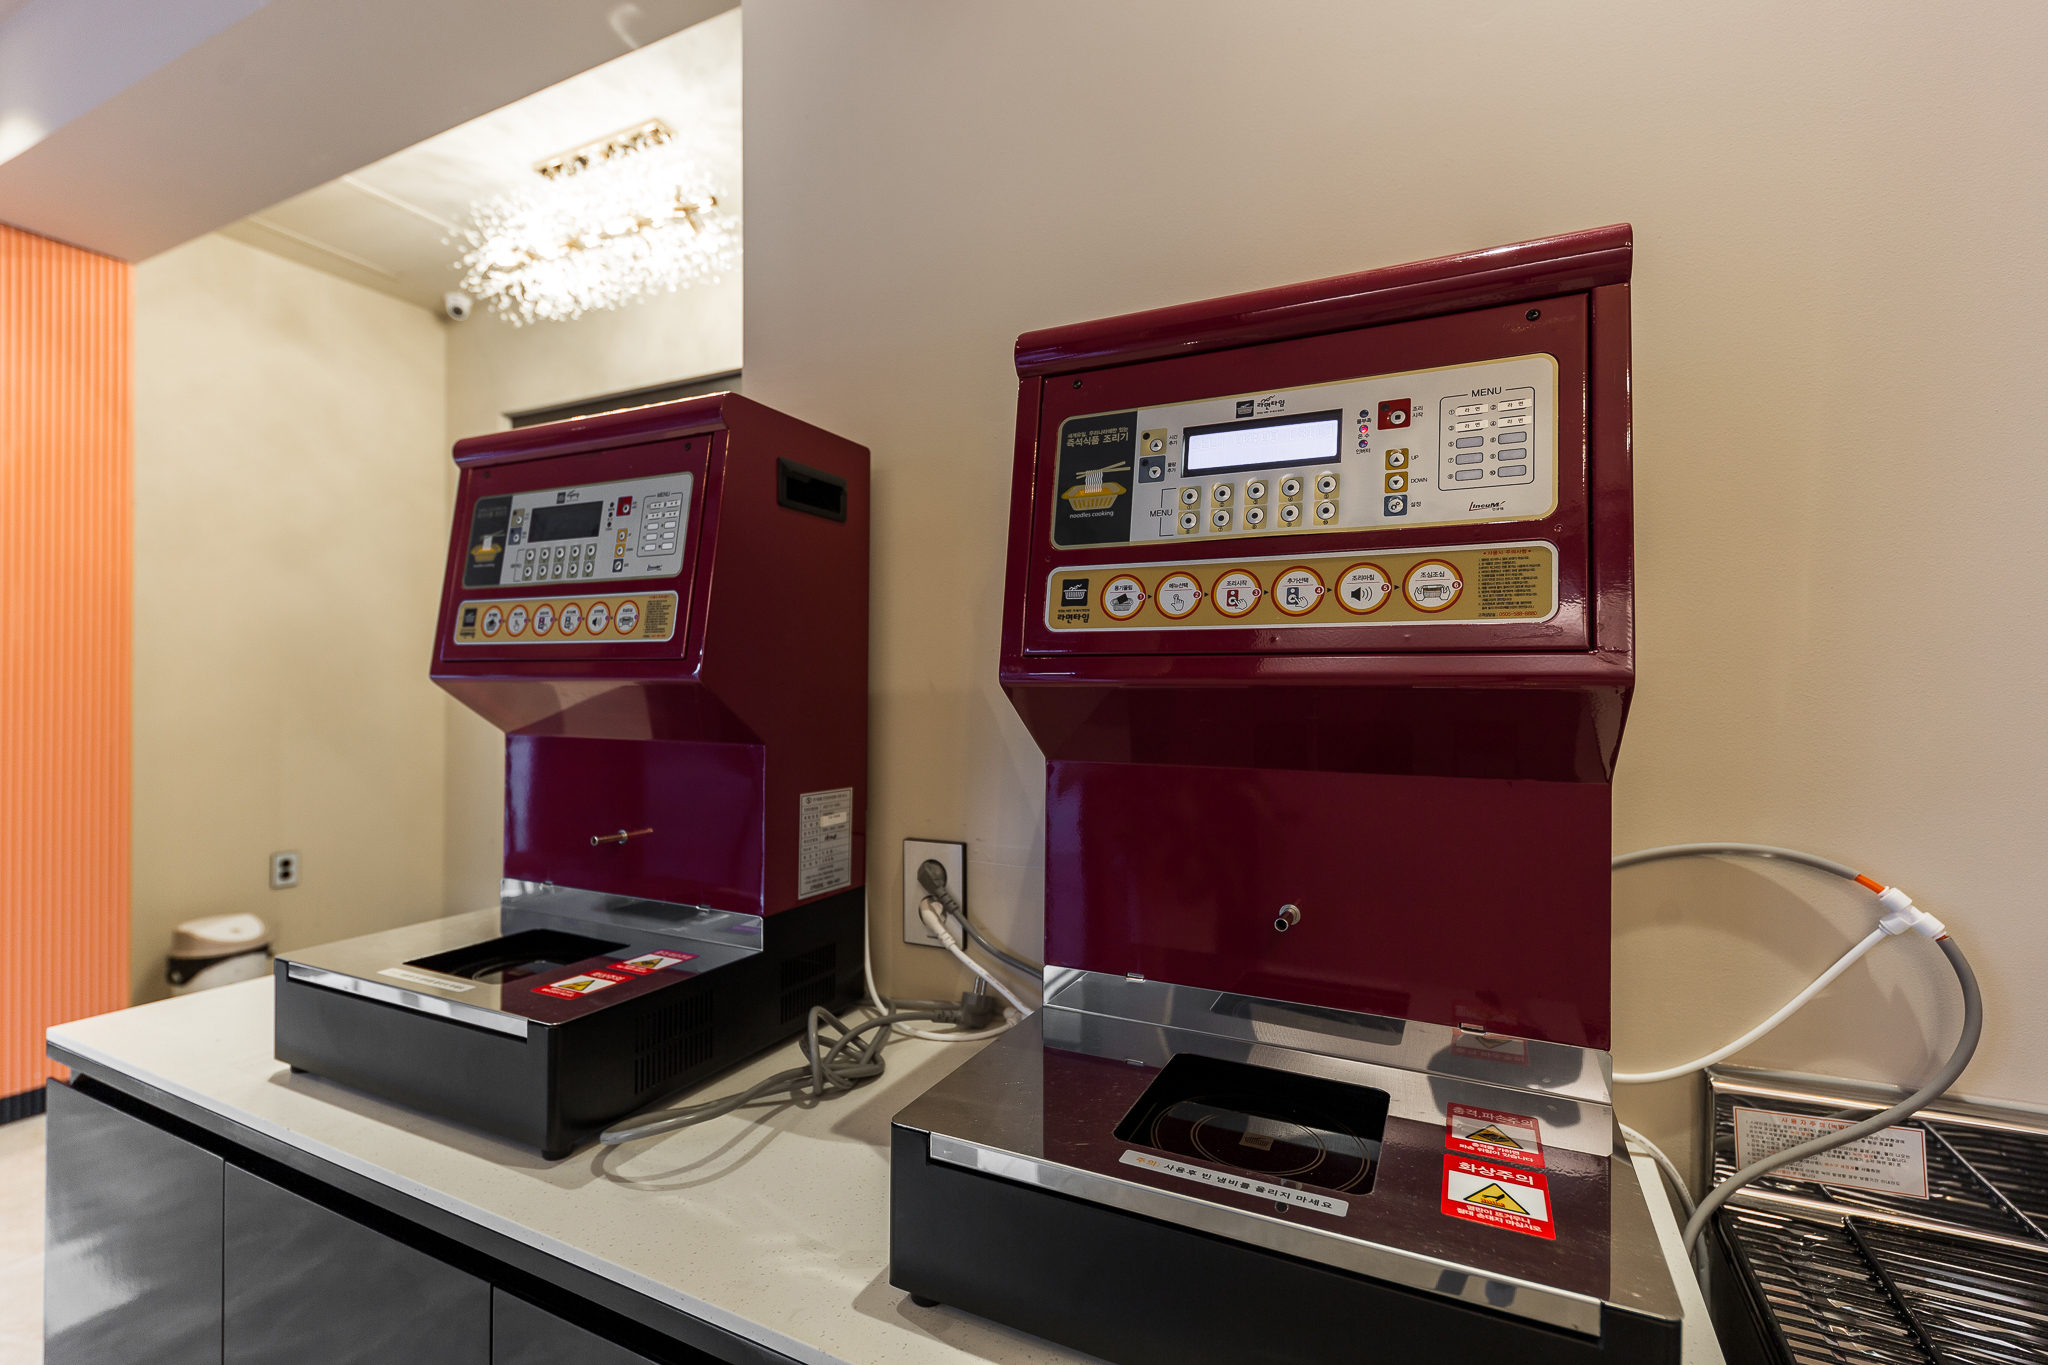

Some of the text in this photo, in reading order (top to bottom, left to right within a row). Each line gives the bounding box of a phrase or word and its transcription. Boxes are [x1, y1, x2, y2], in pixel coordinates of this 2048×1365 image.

[1472, 387, 1501, 397] MENU
[1066, 432, 1129, 447] 즉석식품 조리기
[1070, 510, 1114, 519] noodles cooking
[1150, 509, 1173, 517] MENU
[1058, 613, 1089, 623] 라면타임
[1477, 1146, 1500, 1156] 위험이
[1502, 1152, 1533, 1163] 있습니다
[1458, 1161, 1534, 1186] 화상주의
[1136, 1156, 1333, 1209] 주의: 사용후 빈 냄비를 올리지 마세요
[1457, 1208, 1542, 1232] 절대 손대지 마십시오
[1496, 1210, 1530, 1224] 뜨거우니
